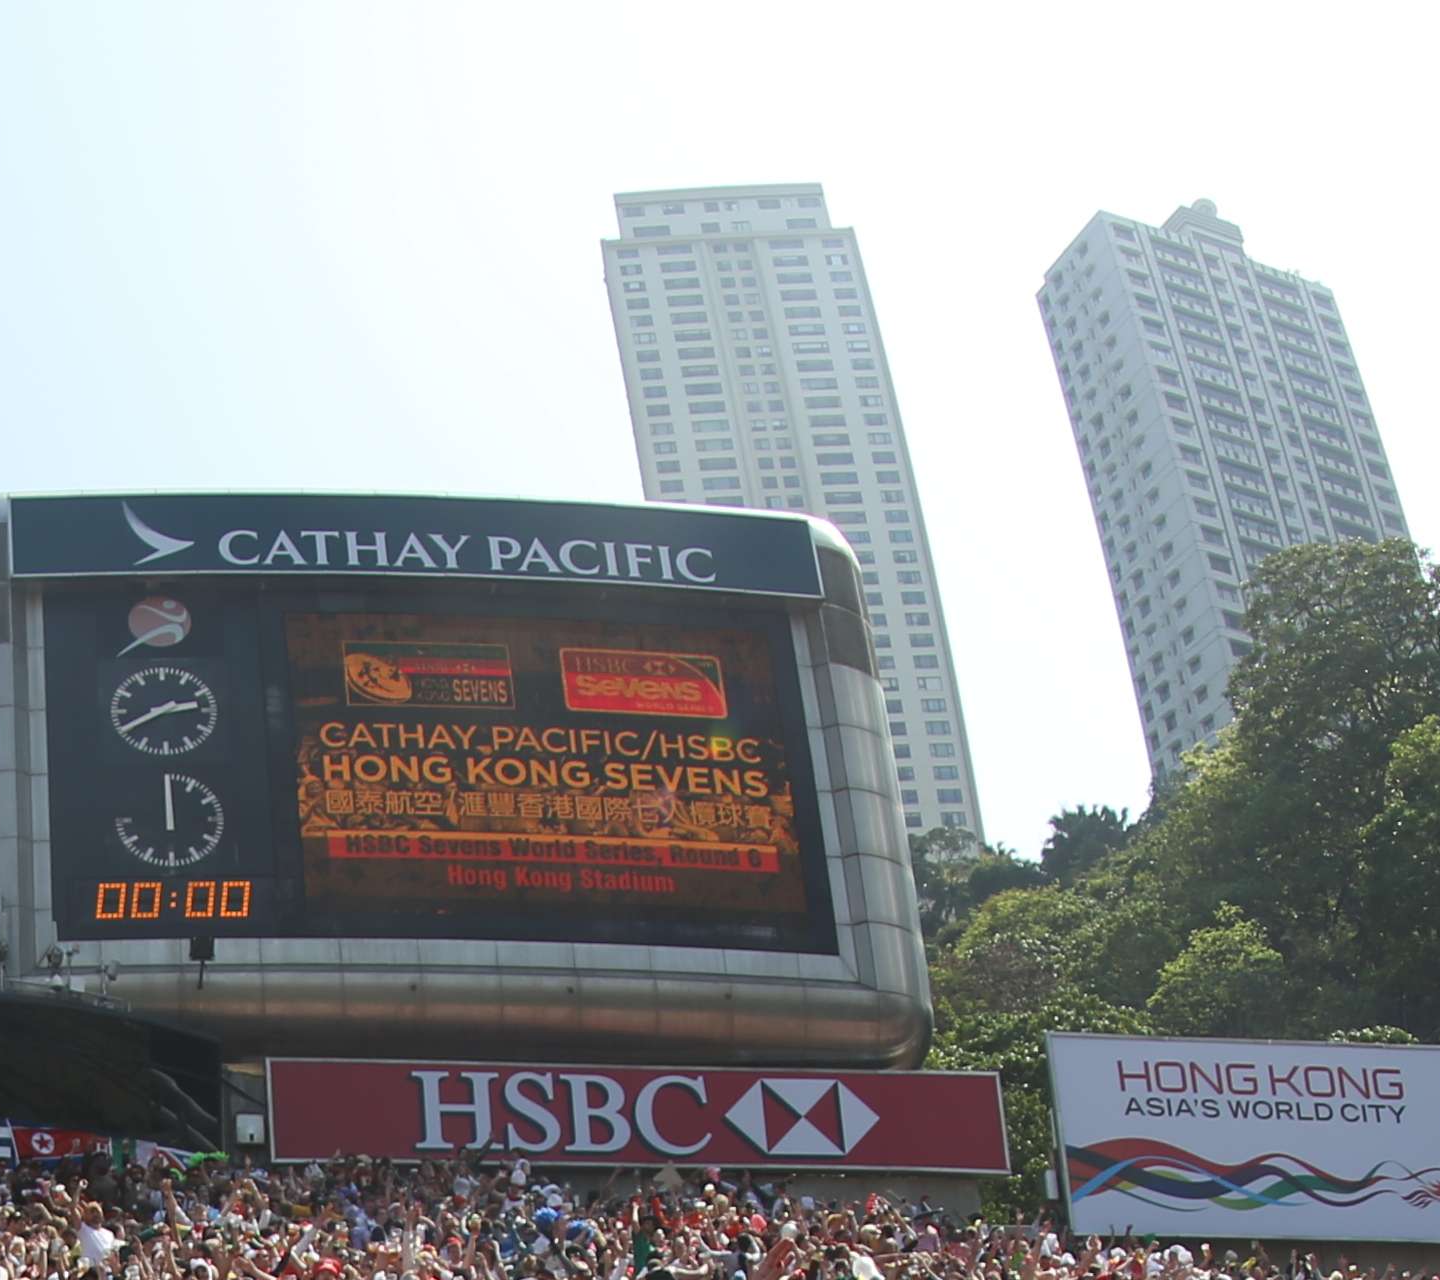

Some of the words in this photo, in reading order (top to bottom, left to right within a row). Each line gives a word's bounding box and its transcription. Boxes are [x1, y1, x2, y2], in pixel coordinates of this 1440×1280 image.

[216, 529, 469, 573] CATHAY
[487, 535, 718, 584] PACIFIC
[452, 679, 508, 703] SEVENS
[320, 720, 478, 751] CATHAY
[493, 726, 763, 764] PACIFIC/HSBC
[322, 754, 454, 786] HONG
[467, 757, 591, 789] KONG
[605, 763, 770, 798] SEVENS
[94, 878, 252, 921] 00:00
[447, 863, 508, 891] Hong
[515, 866, 572, 893] Kong
[581, 868, 675, 894] Stadium
[1117, 1059, 1258, 1097] HONG
[1268, 1063, 1405, 1100] KONG
[411, 1069, 715, 1158] HSBC
[1124, 1097, 1221, 1119] ASIA'S
[1228, 1099, 1333, 1122] WORLD
[1340, 1102, 1407, 1125] CITY
